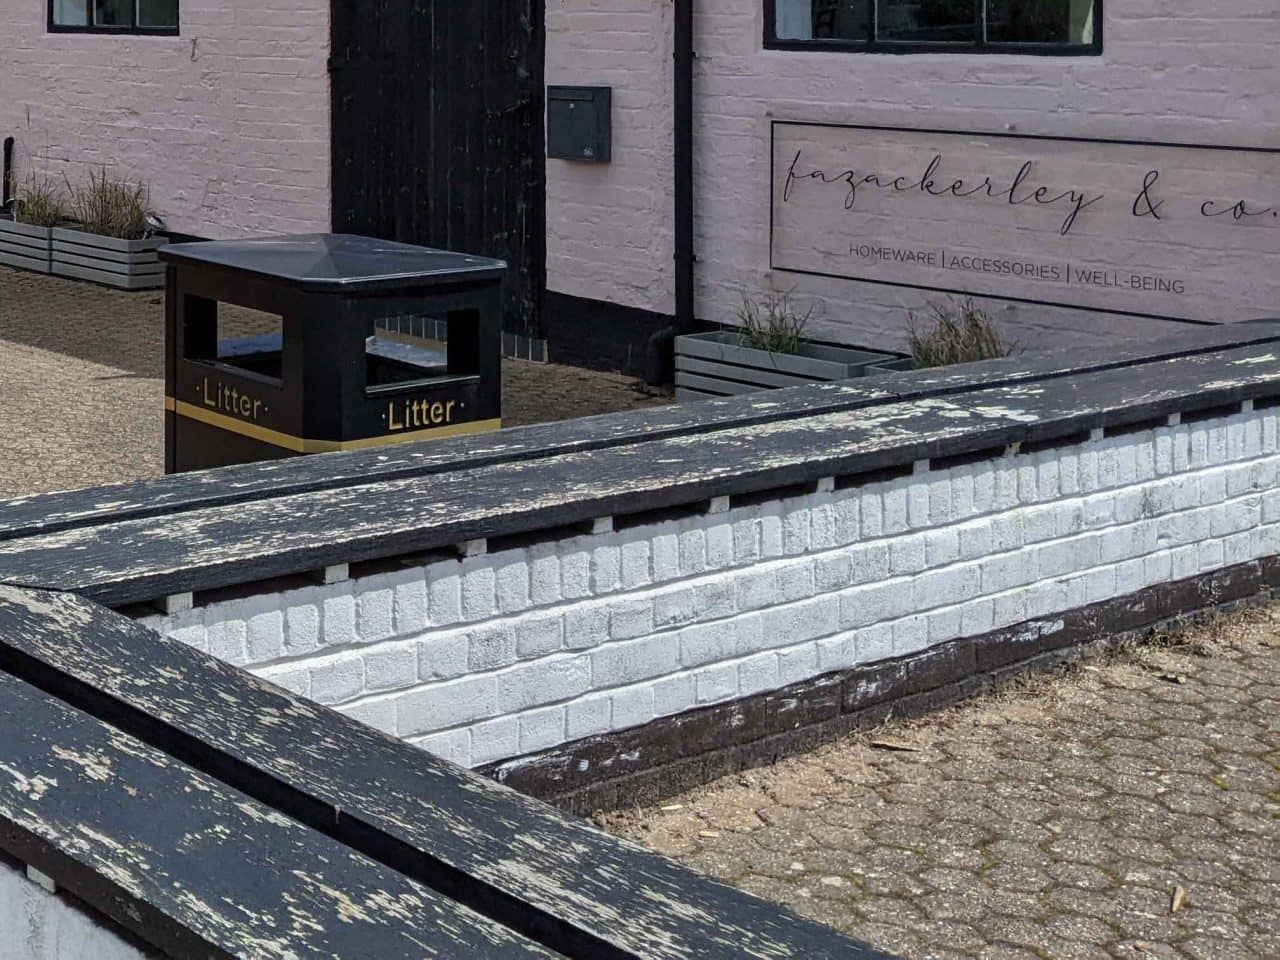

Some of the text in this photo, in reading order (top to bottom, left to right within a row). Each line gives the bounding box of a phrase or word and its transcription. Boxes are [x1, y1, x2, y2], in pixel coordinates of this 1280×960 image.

[783, 149, 1104, 236] fazackerley
[1132, 170, 1165, 220] &
[849, 243, 1185, 295] HOMEWARE ACCESSORIES WELL-BEING
[203, 377, 261, 420] Litter
[388, 399, 455, 430] Litter
